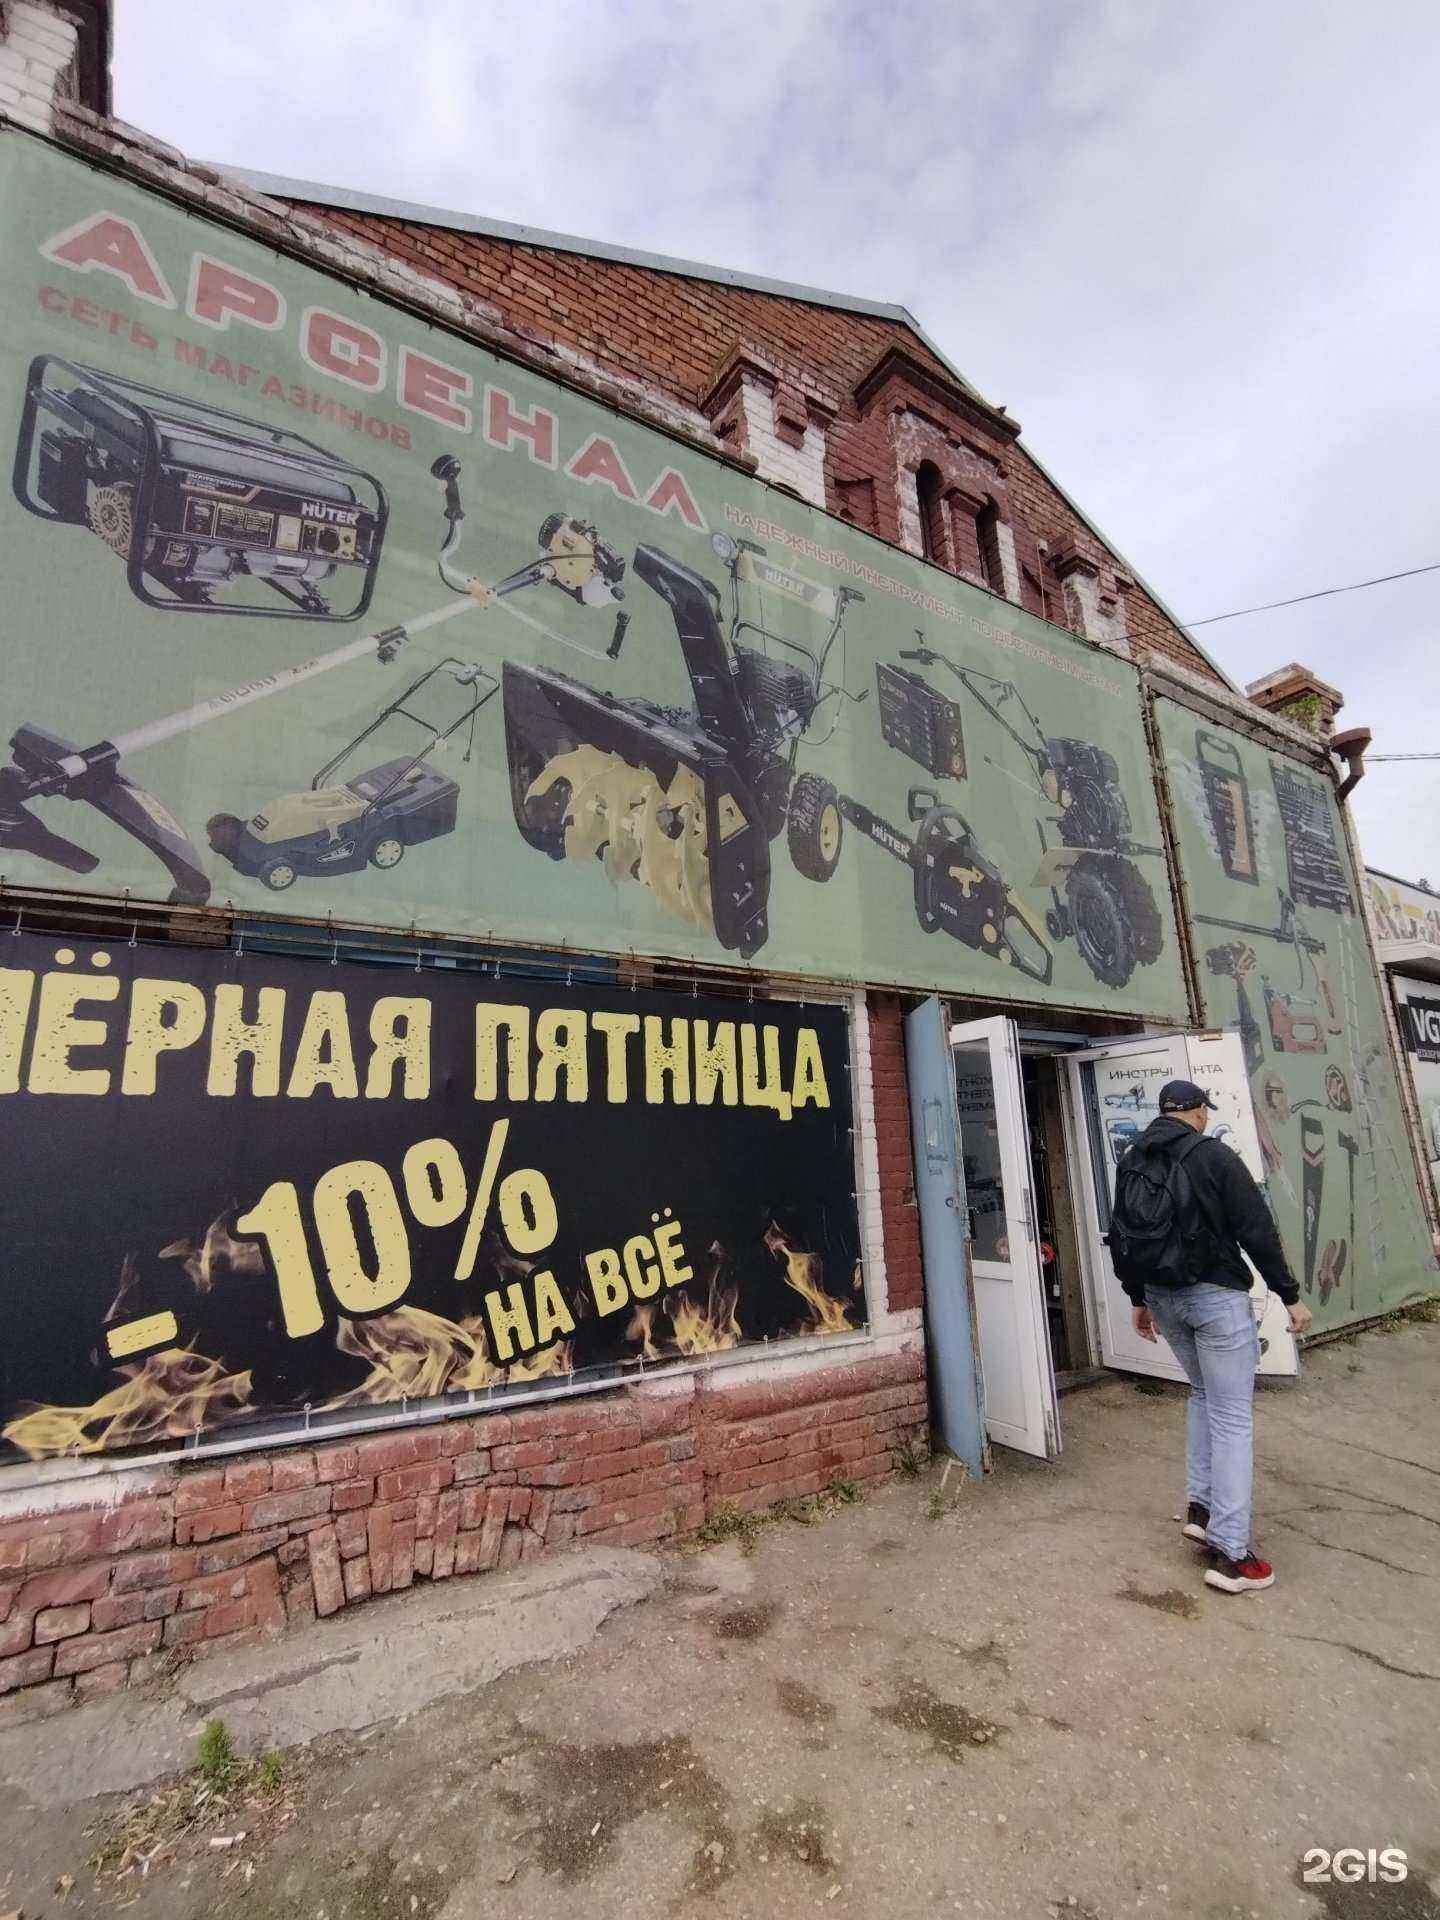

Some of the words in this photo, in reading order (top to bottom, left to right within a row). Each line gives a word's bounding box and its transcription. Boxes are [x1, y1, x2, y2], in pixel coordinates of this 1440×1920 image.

[37, 286, 159, 352] СЕТЬ
[174, 337, 412, 450] МАГАЗИНОВ
[39, 211, 710, 533] АРСЕНАЛ
[724, 504, 851, 576] НАДЕЖНЫЙ
[474, 1001, 831, 1120] ПЯТНИЦА
[1411, 1006, 1440, 1045] VG
[485, 1279, 576, 1361] НА
[586, 1208, 694, 1318] ВСЁ
